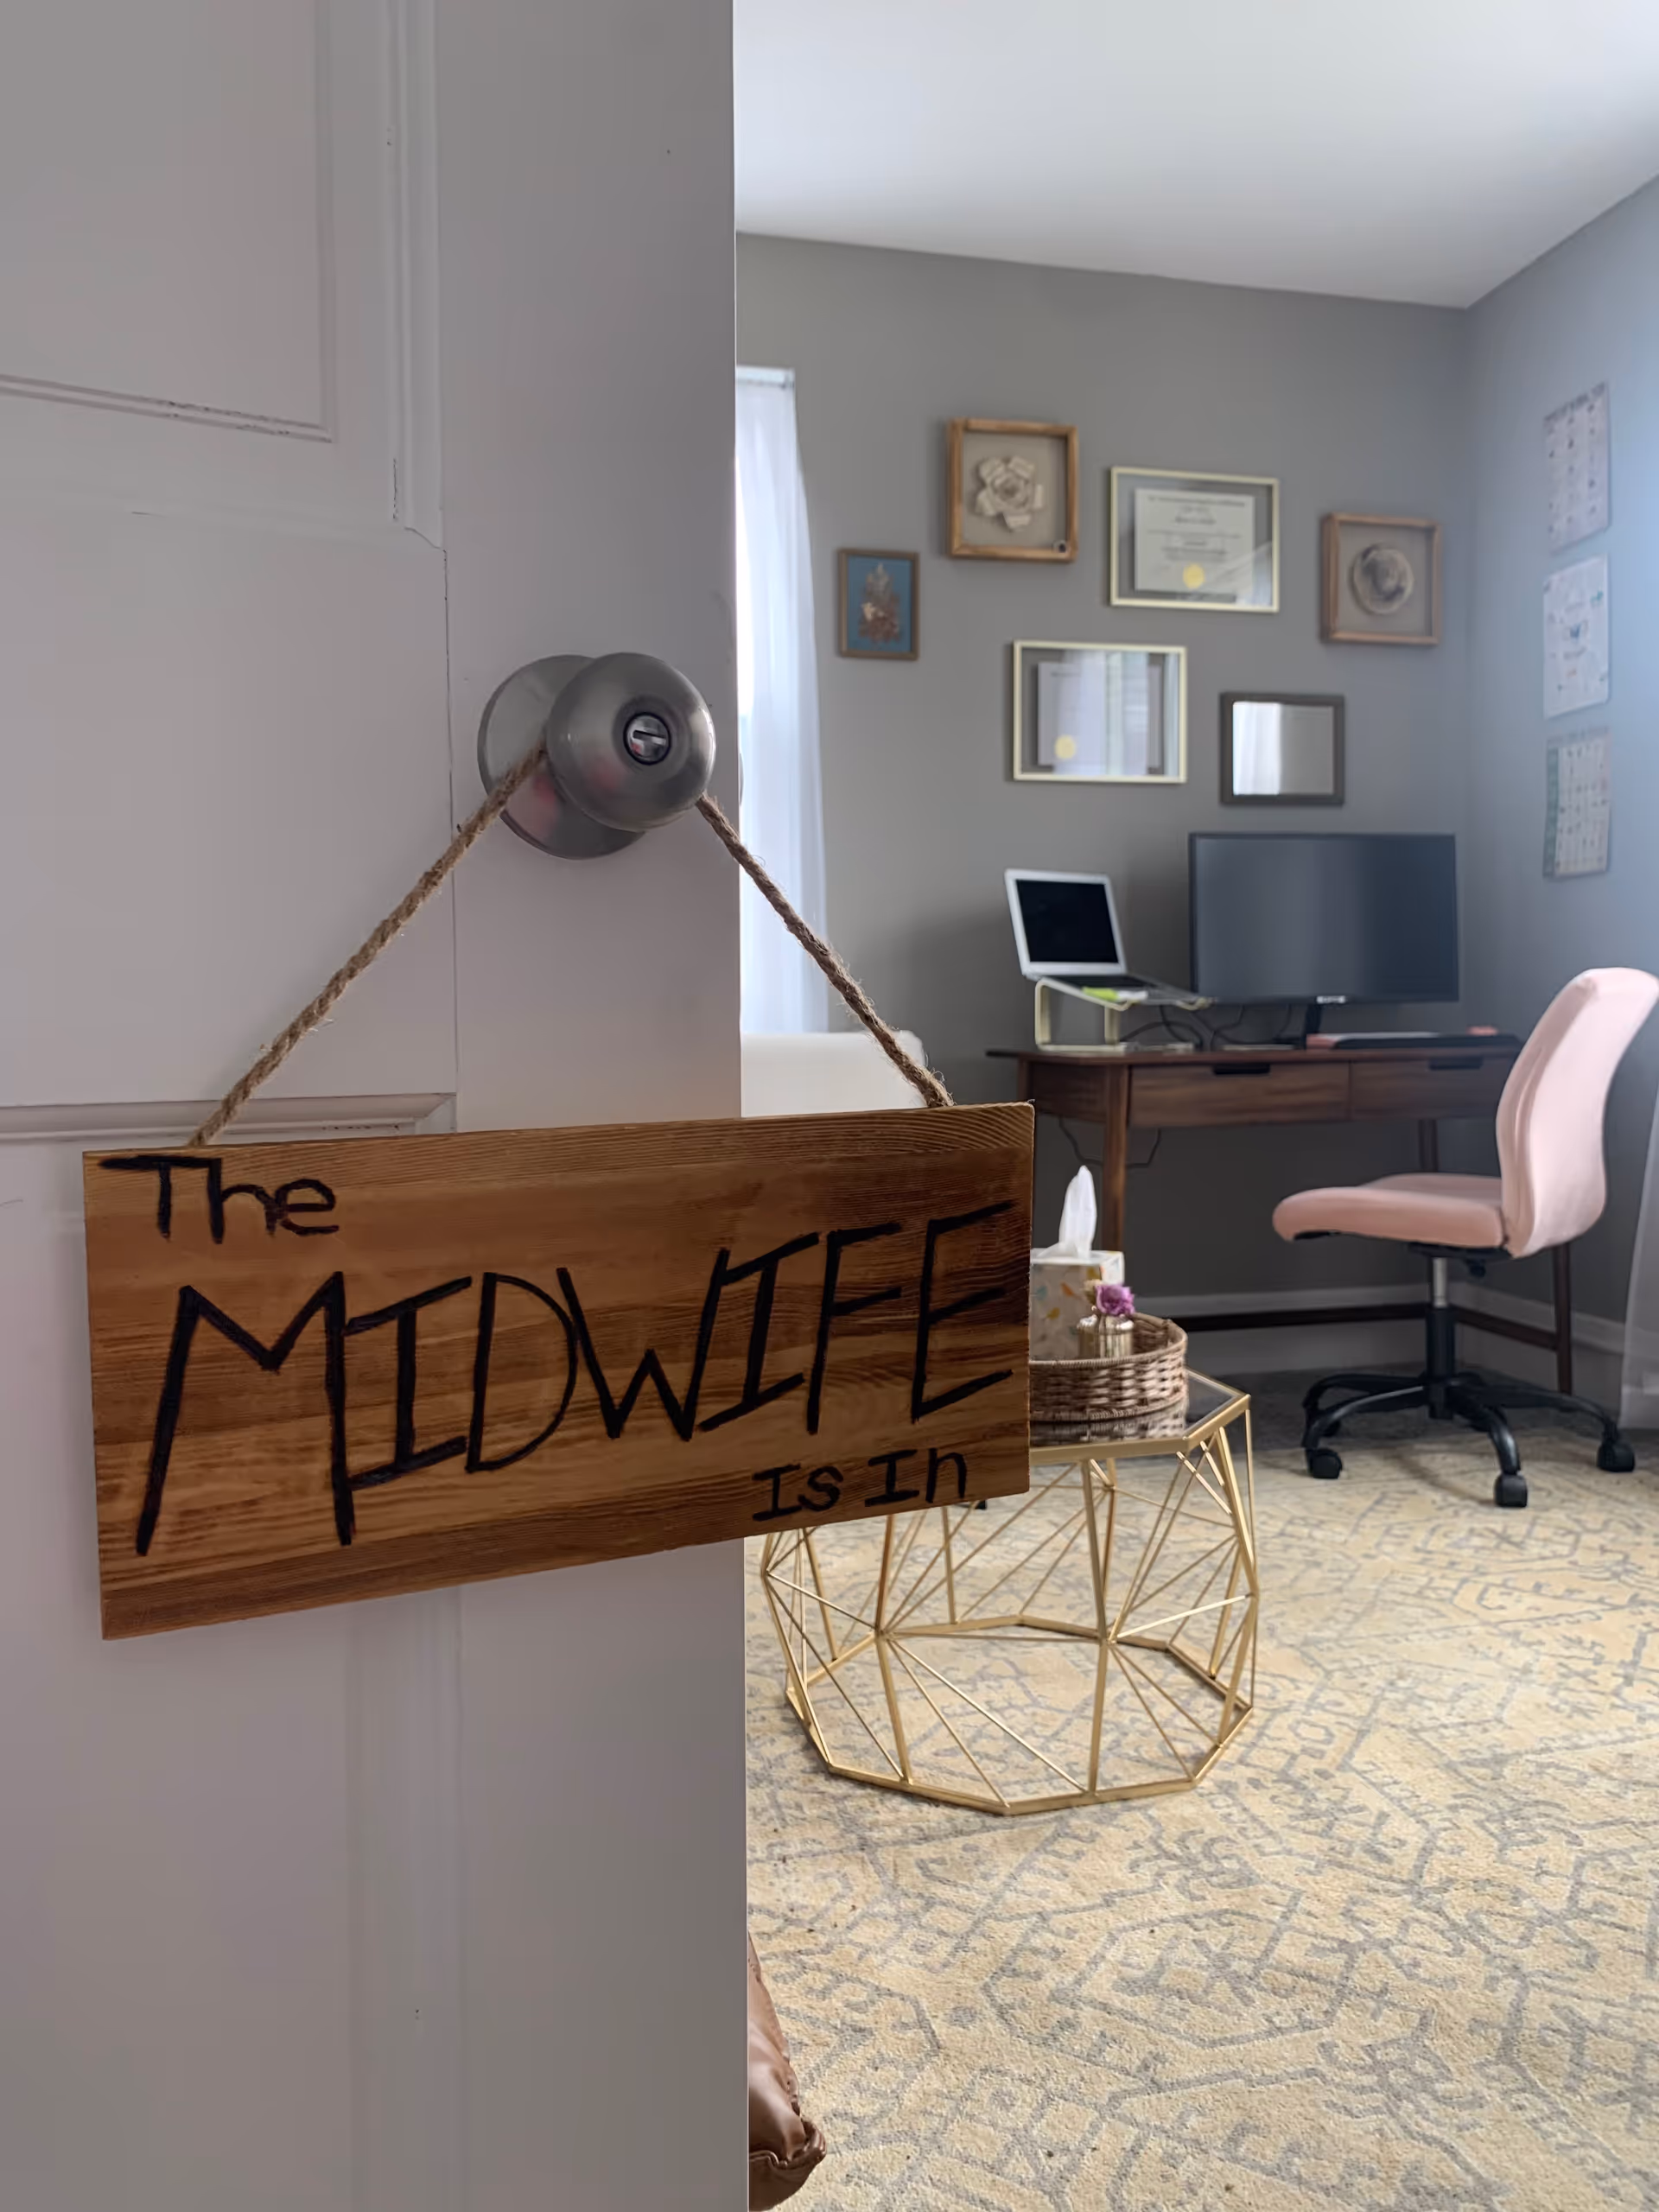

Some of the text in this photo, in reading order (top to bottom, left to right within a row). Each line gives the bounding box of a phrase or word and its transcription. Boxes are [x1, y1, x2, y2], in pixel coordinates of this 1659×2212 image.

[99, 1154, 340, 1244] The
[136, 1202, 1014, 1555] MIDWIFE
[752, 1446, 968, 1522] Is In
